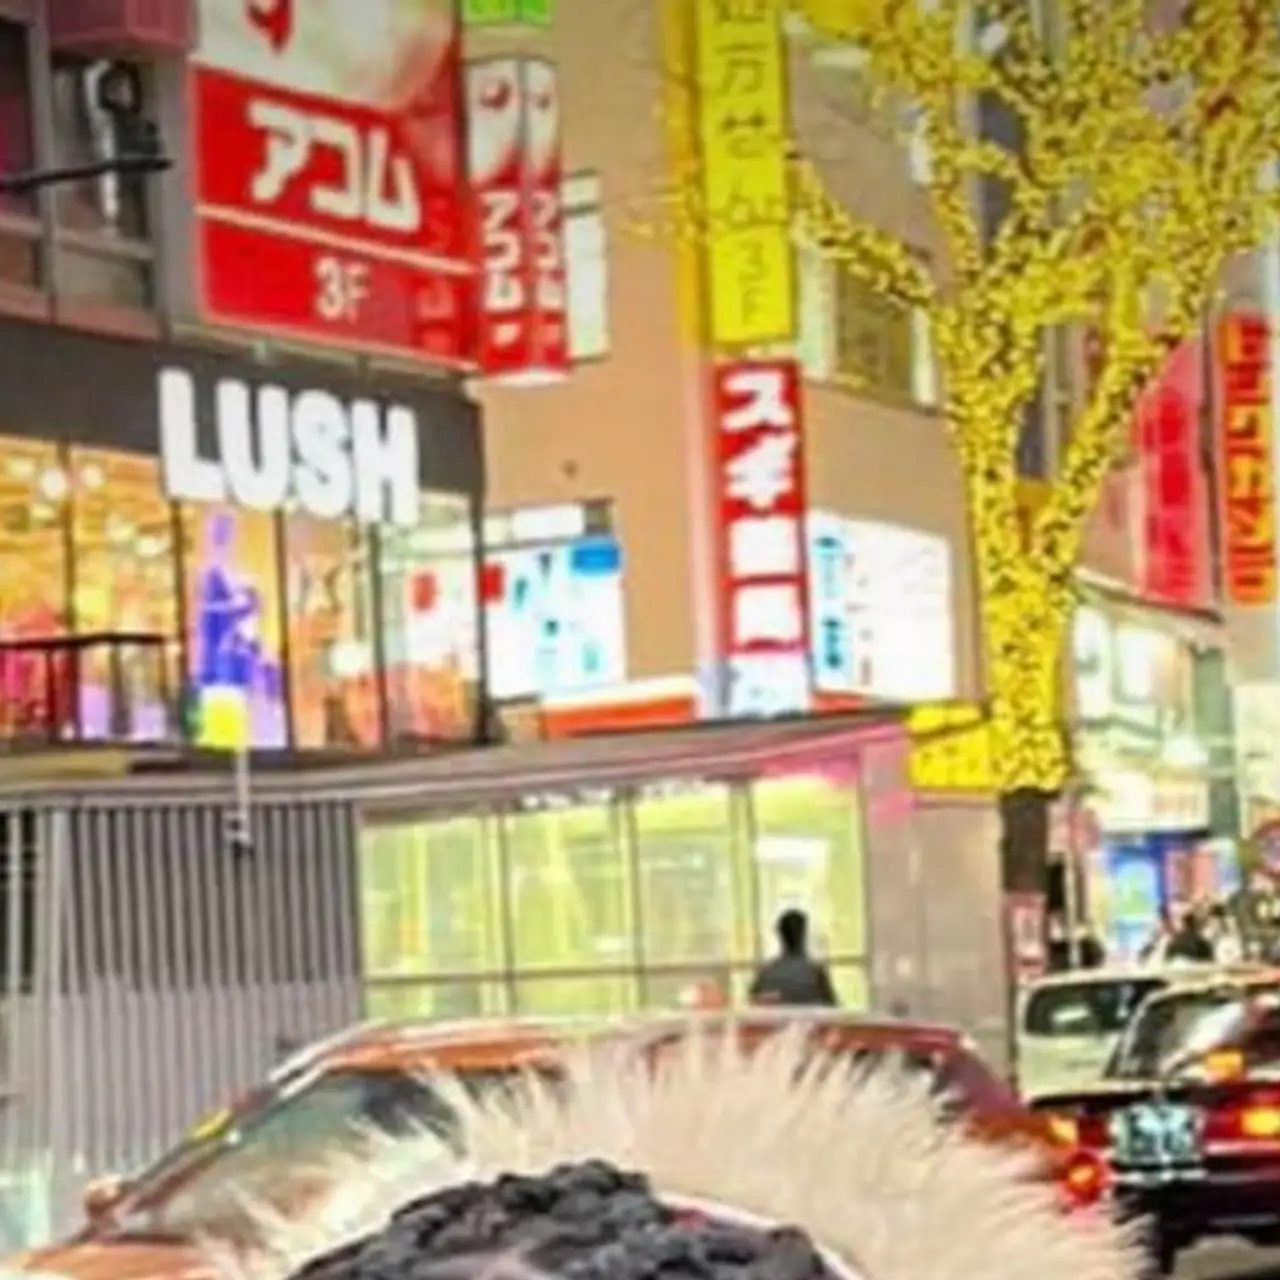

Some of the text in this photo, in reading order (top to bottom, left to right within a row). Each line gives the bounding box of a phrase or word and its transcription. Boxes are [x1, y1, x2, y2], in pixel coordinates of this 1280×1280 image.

[246, 98, 422, 233] アコム
[315, 255, 372, 327] 3F
[156, 365, 420, 526] LUSH
[720, 366, 802, 642] スギ
